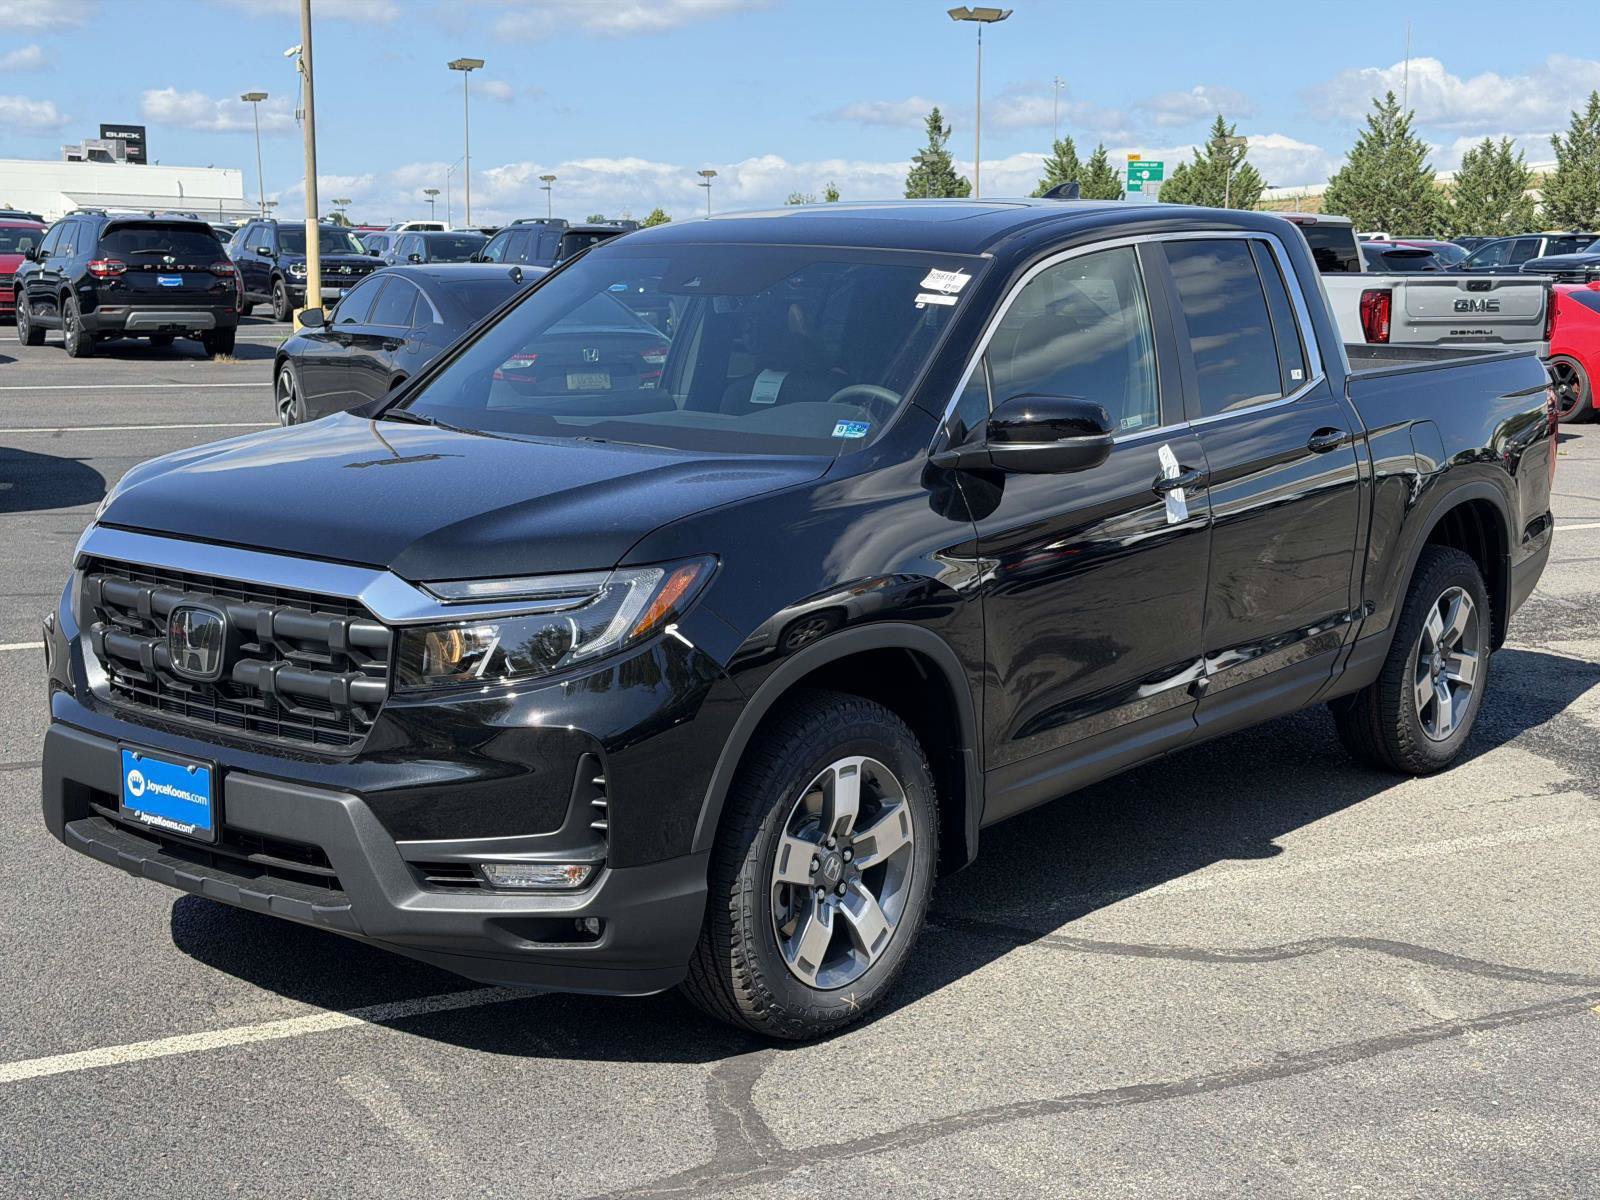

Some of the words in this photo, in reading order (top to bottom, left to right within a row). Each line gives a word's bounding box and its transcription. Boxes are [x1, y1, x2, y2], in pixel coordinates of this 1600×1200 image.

[105, 131, 141, 139] BUICK
[1454, 299, 1500, 312] GMC
[146, 779, 208, 806] JoyceKoons.com
[140, 811, 193, 834] JoyceKoons.com
